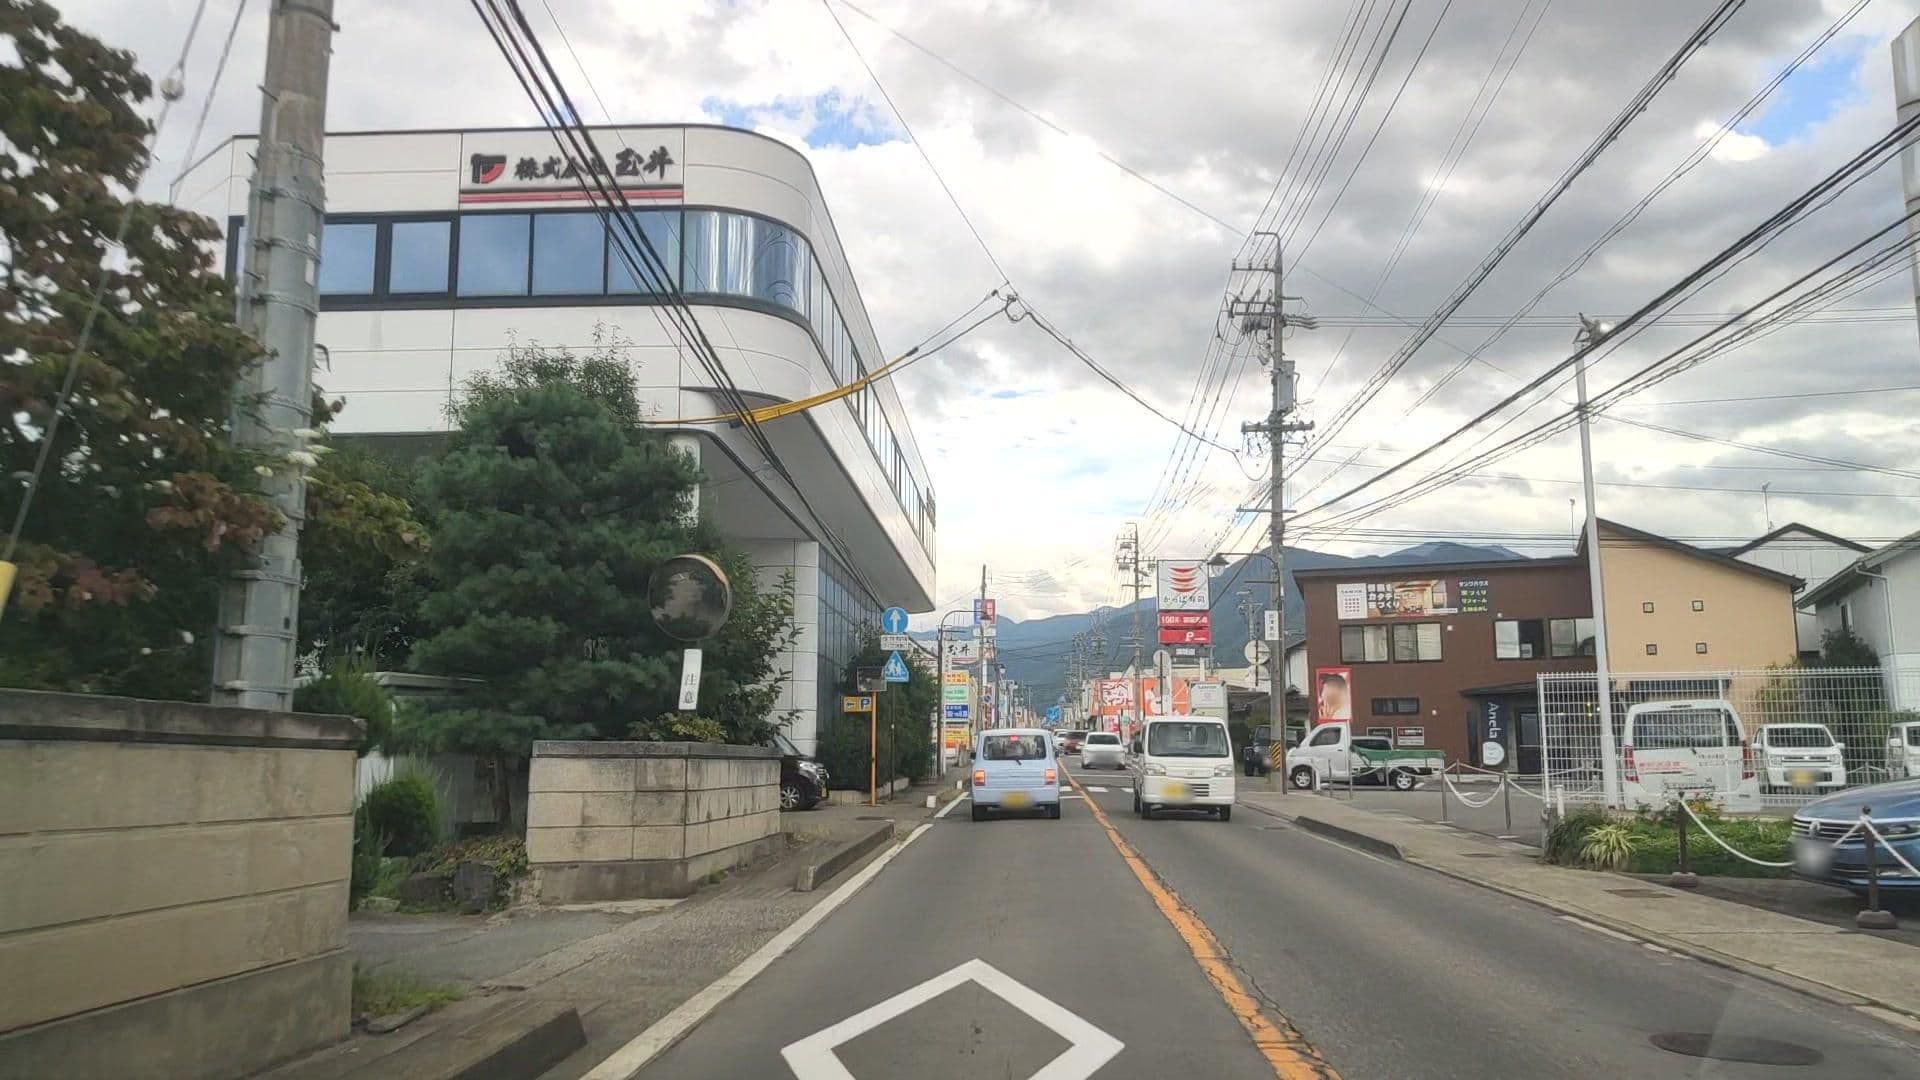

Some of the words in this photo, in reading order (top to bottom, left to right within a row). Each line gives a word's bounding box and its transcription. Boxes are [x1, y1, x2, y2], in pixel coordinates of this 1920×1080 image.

[684, 672, 697, 704] 注意
[860, 697, 870, 711] P
[1487, 701, 1502, 739] Aneta
